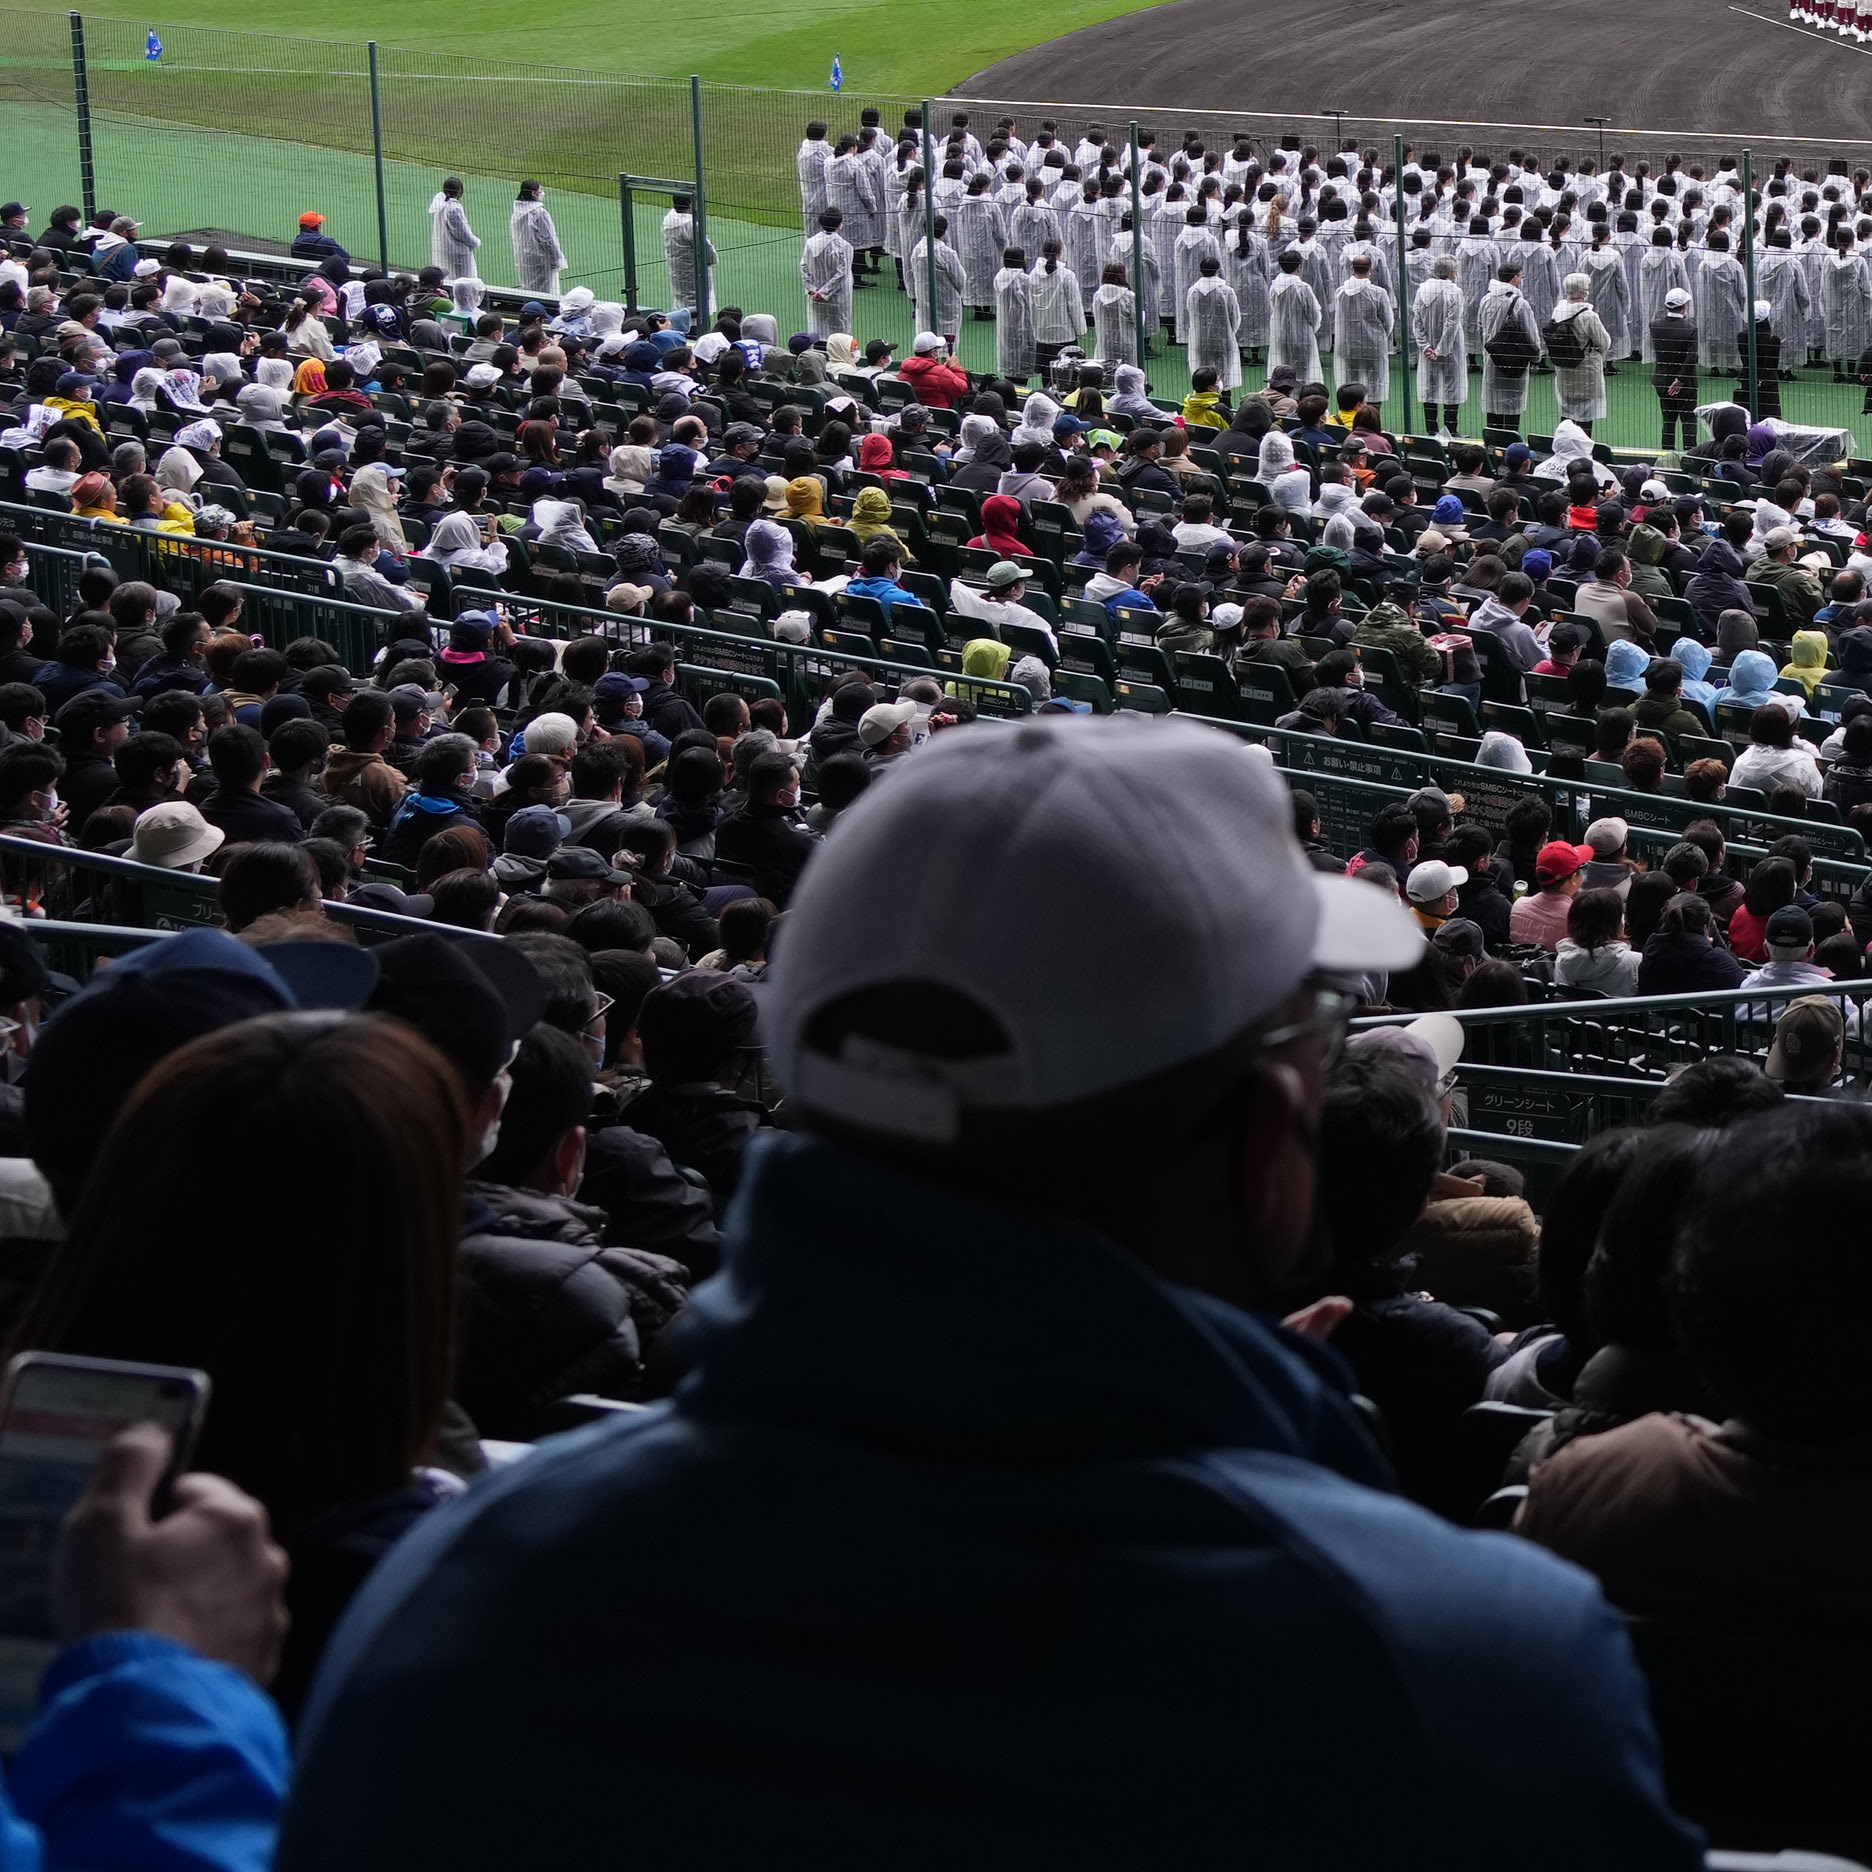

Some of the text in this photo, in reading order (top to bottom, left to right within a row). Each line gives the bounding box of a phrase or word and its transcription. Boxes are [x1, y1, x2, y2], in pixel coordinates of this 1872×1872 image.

[1323, 756, 1382, 776] お願い・禁止事項
[1623, 807, 1672, 825] SMBCシート
